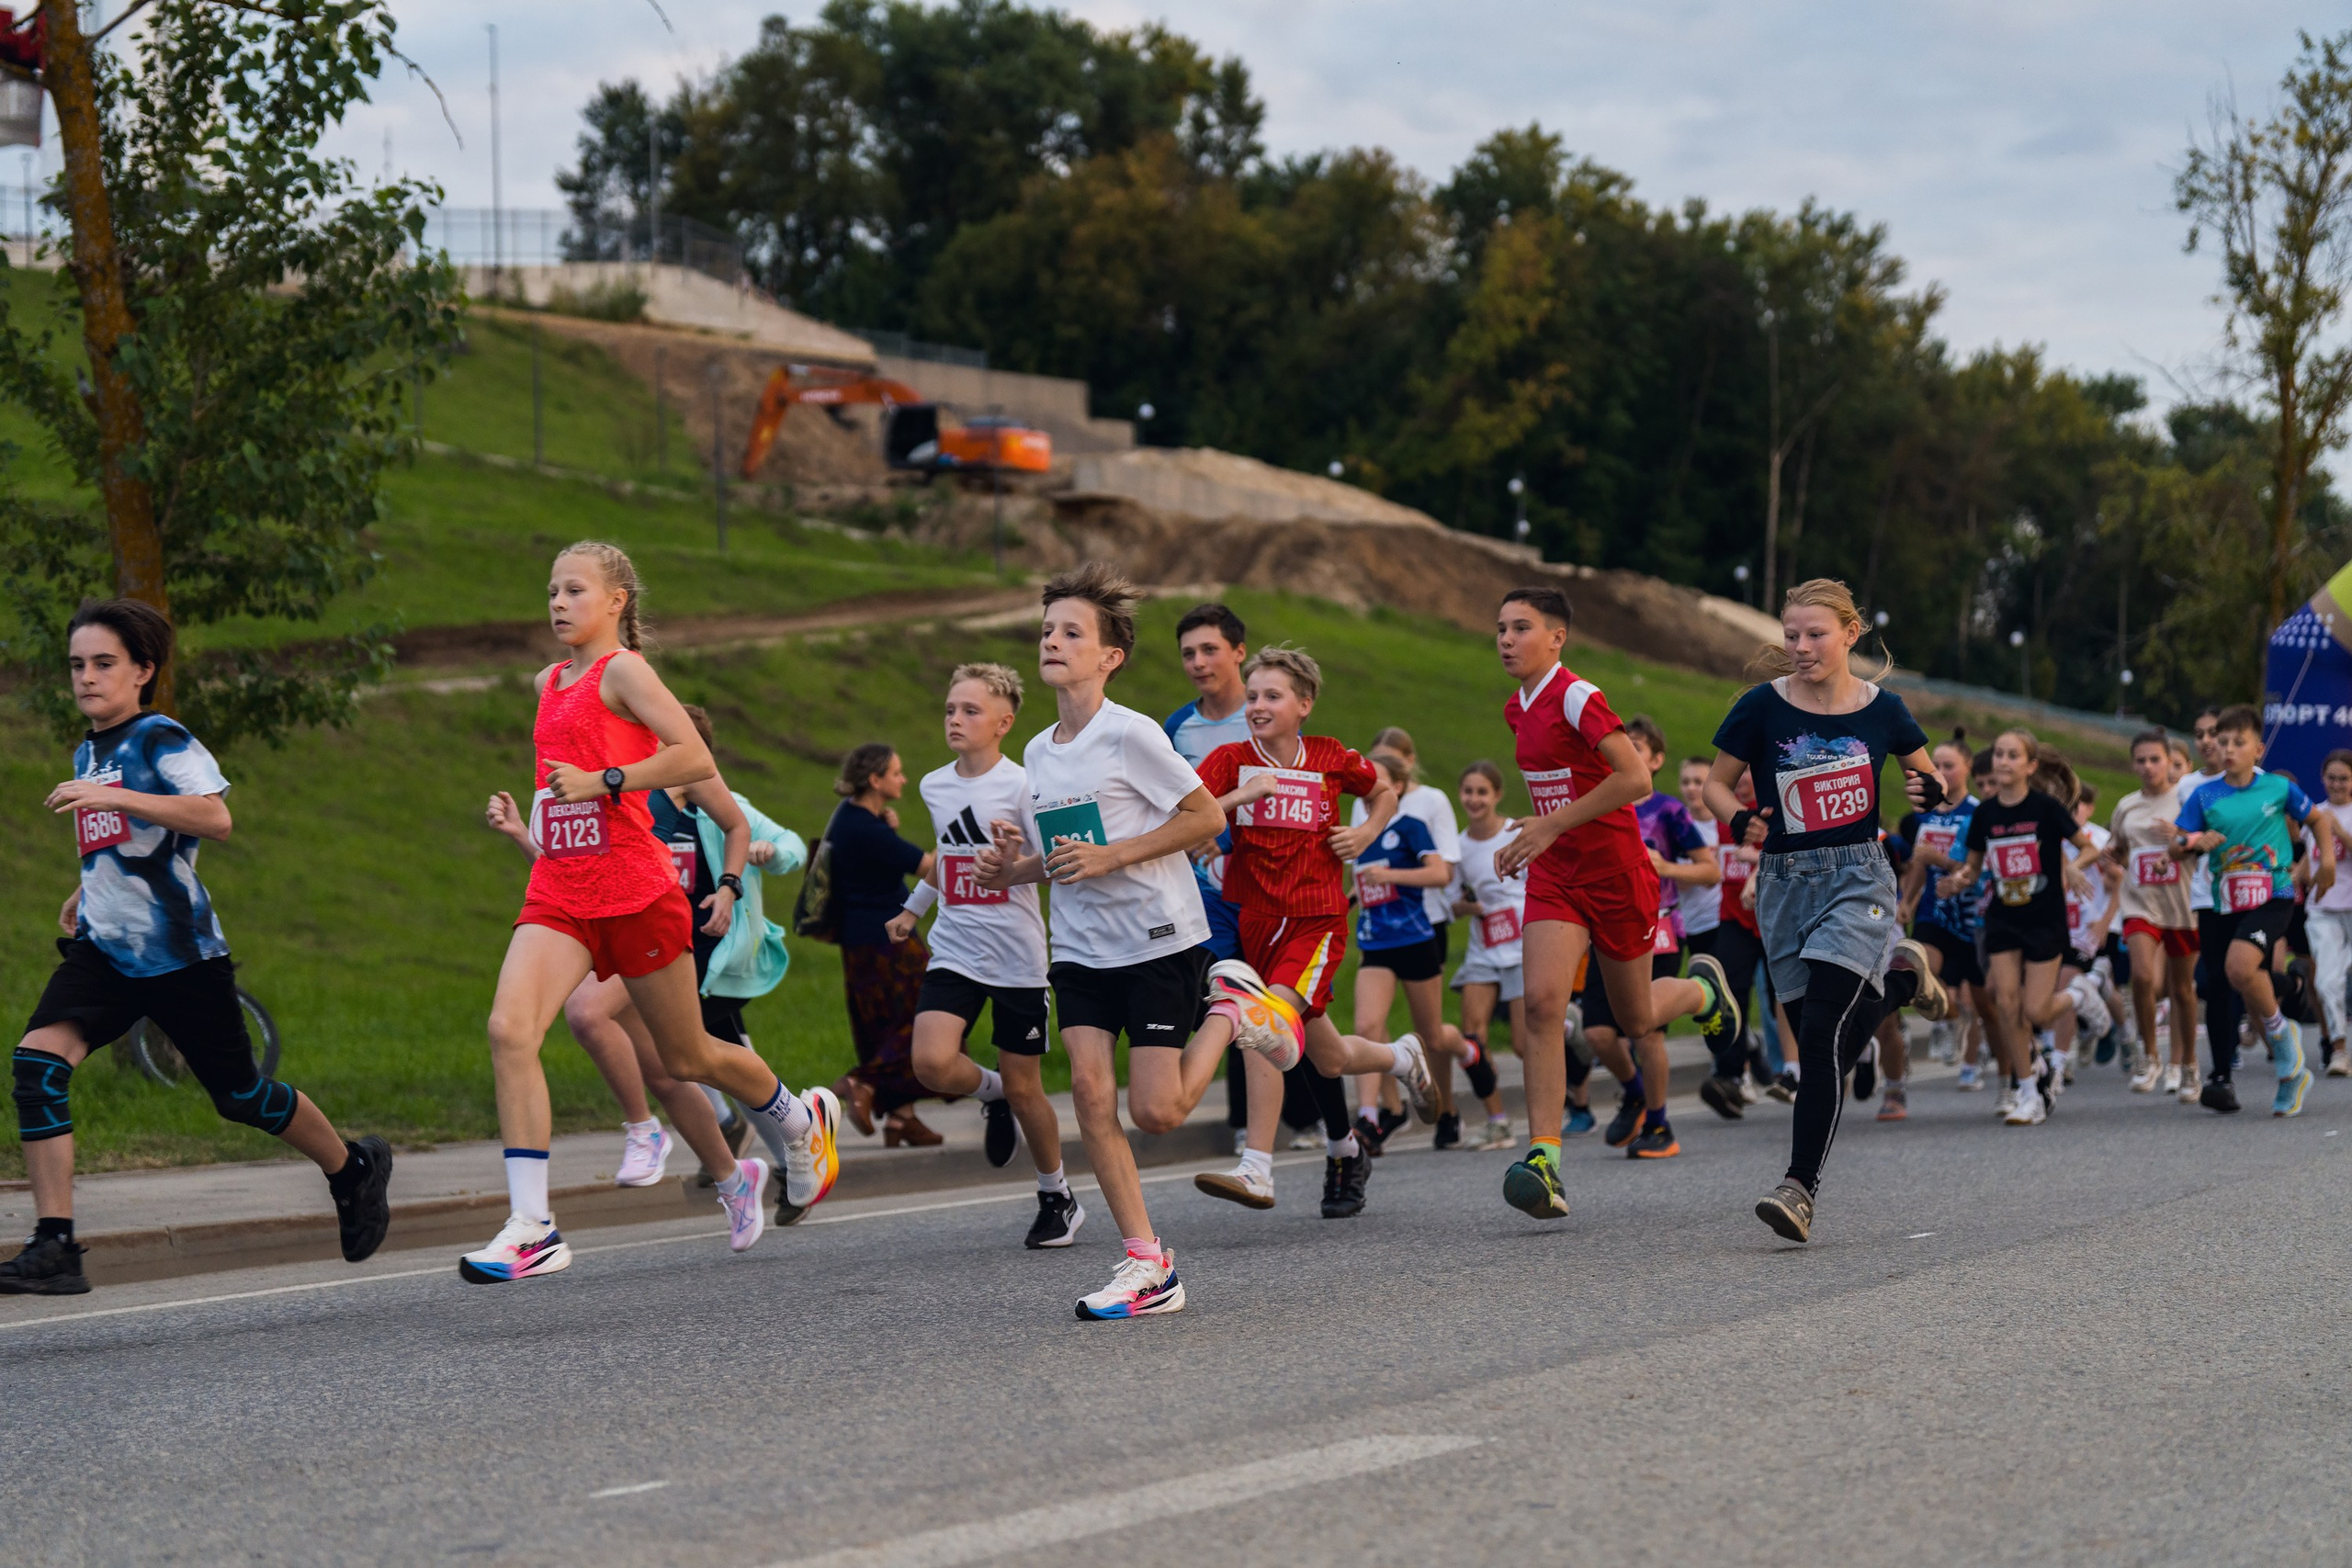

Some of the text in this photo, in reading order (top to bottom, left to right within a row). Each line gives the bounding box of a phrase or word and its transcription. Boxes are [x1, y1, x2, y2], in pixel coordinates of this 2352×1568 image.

[1814, 773, 1861, 793] ВИКТОРИЯ
[548, 801, 601, 818] АЛЕКСАНДРА
[1264, 796, 1313, 823] 3145
[1815, 787, 1869, 821] 1239
[82, 810, 122, 843] 1586
[549, 818, 601, 850] 2123
